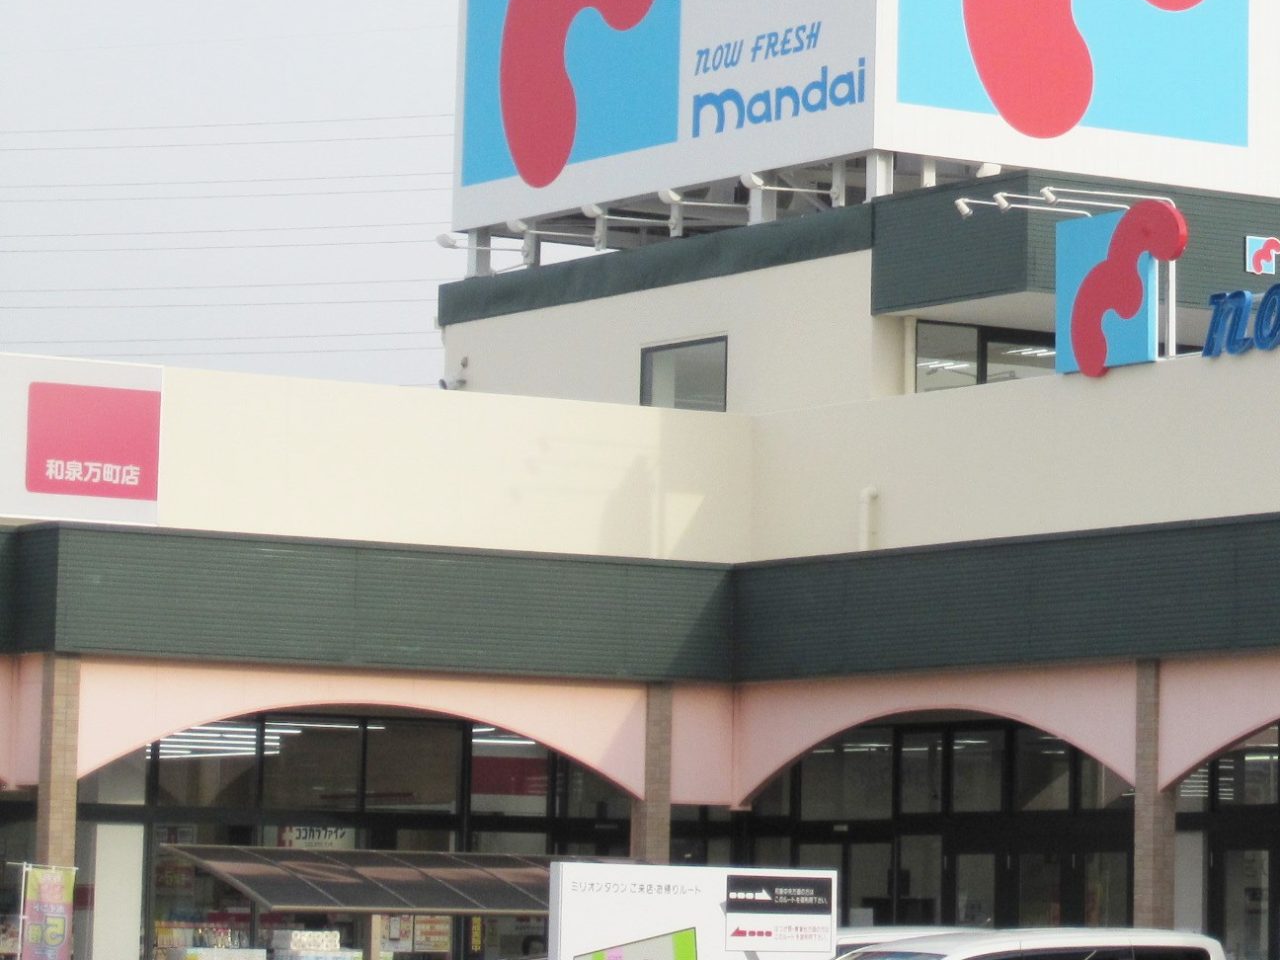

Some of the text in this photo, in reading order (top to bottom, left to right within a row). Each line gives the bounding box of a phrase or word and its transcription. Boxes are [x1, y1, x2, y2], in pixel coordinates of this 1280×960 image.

[750, 21, 822, 63] FRESH
[692, 56, 866, 138] mandai
[45, 458, 141, 486] 和泉万町店
